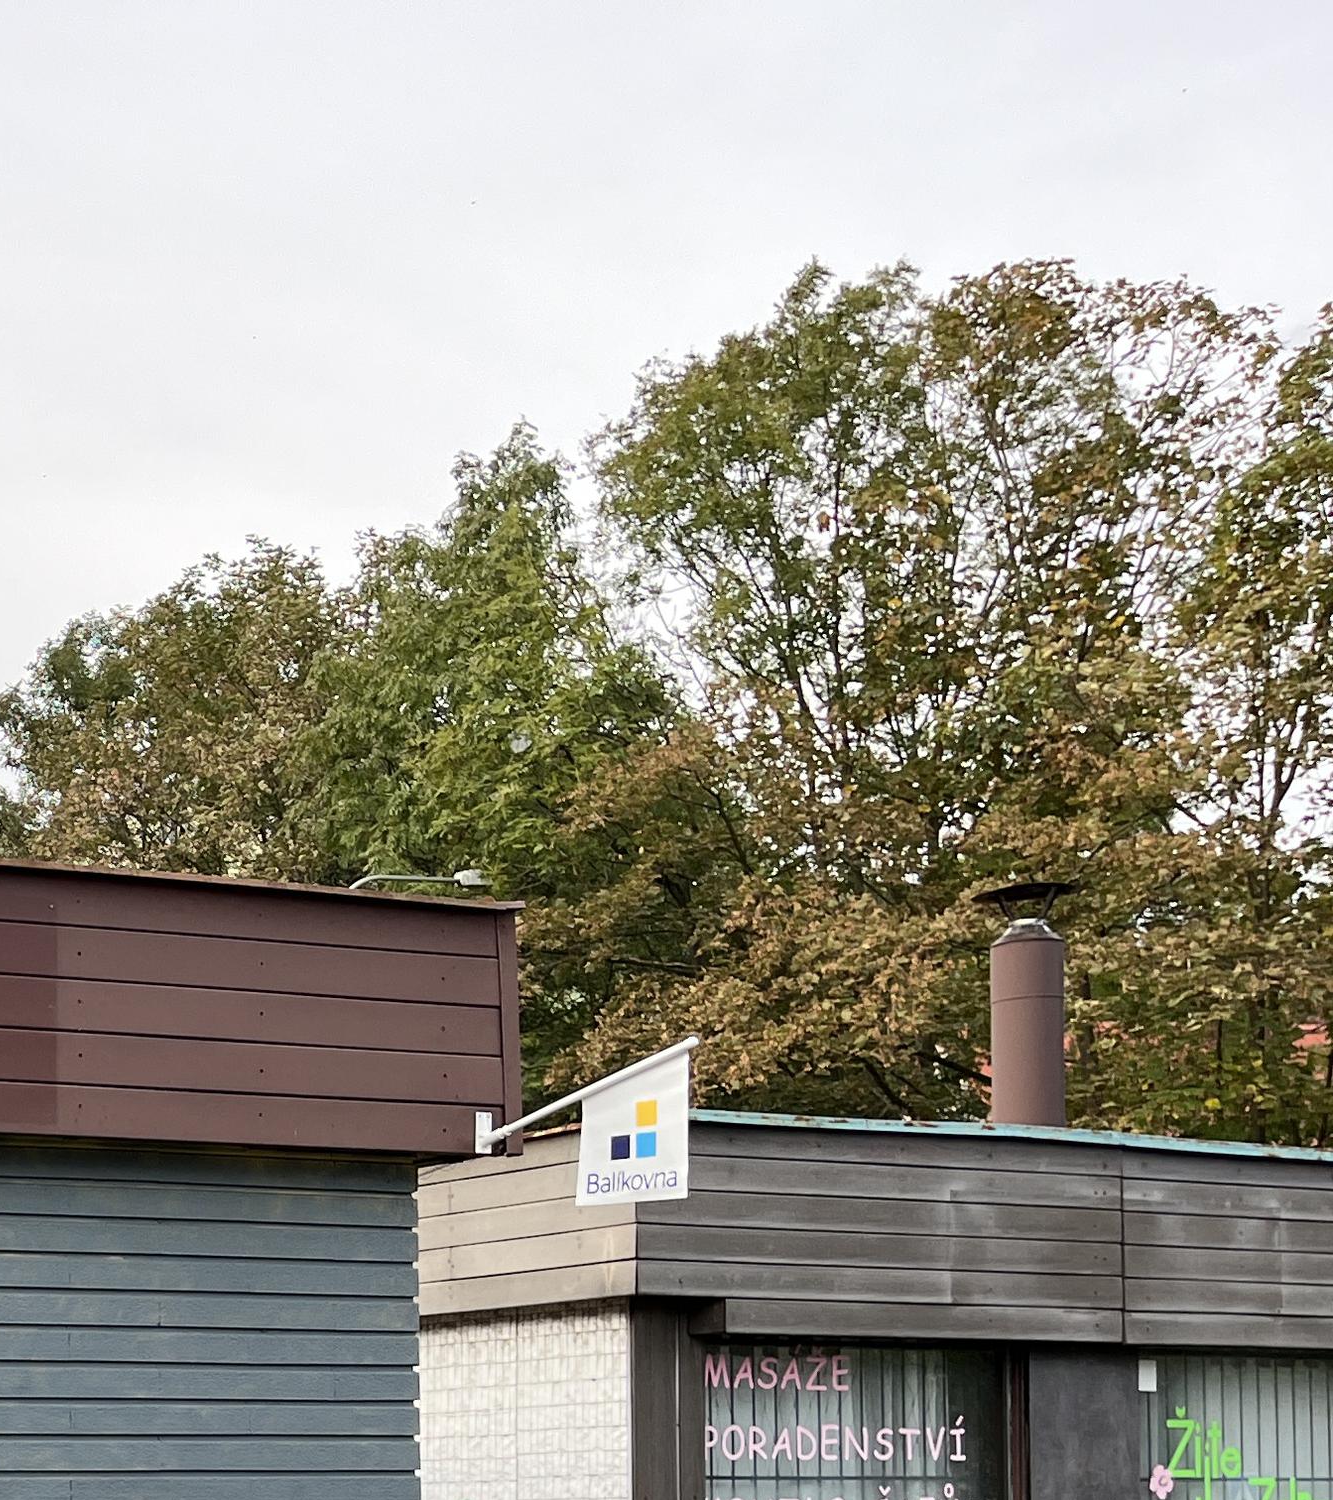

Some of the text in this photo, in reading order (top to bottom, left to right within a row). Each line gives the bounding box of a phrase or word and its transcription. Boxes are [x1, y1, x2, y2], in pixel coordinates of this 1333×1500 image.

[586, 1170, 678, 1195] Balíkovna
[704, 1344, 850, 1392] MASÁŽE
[704, 1414, 968, 1463] PORADENSTVÍ
